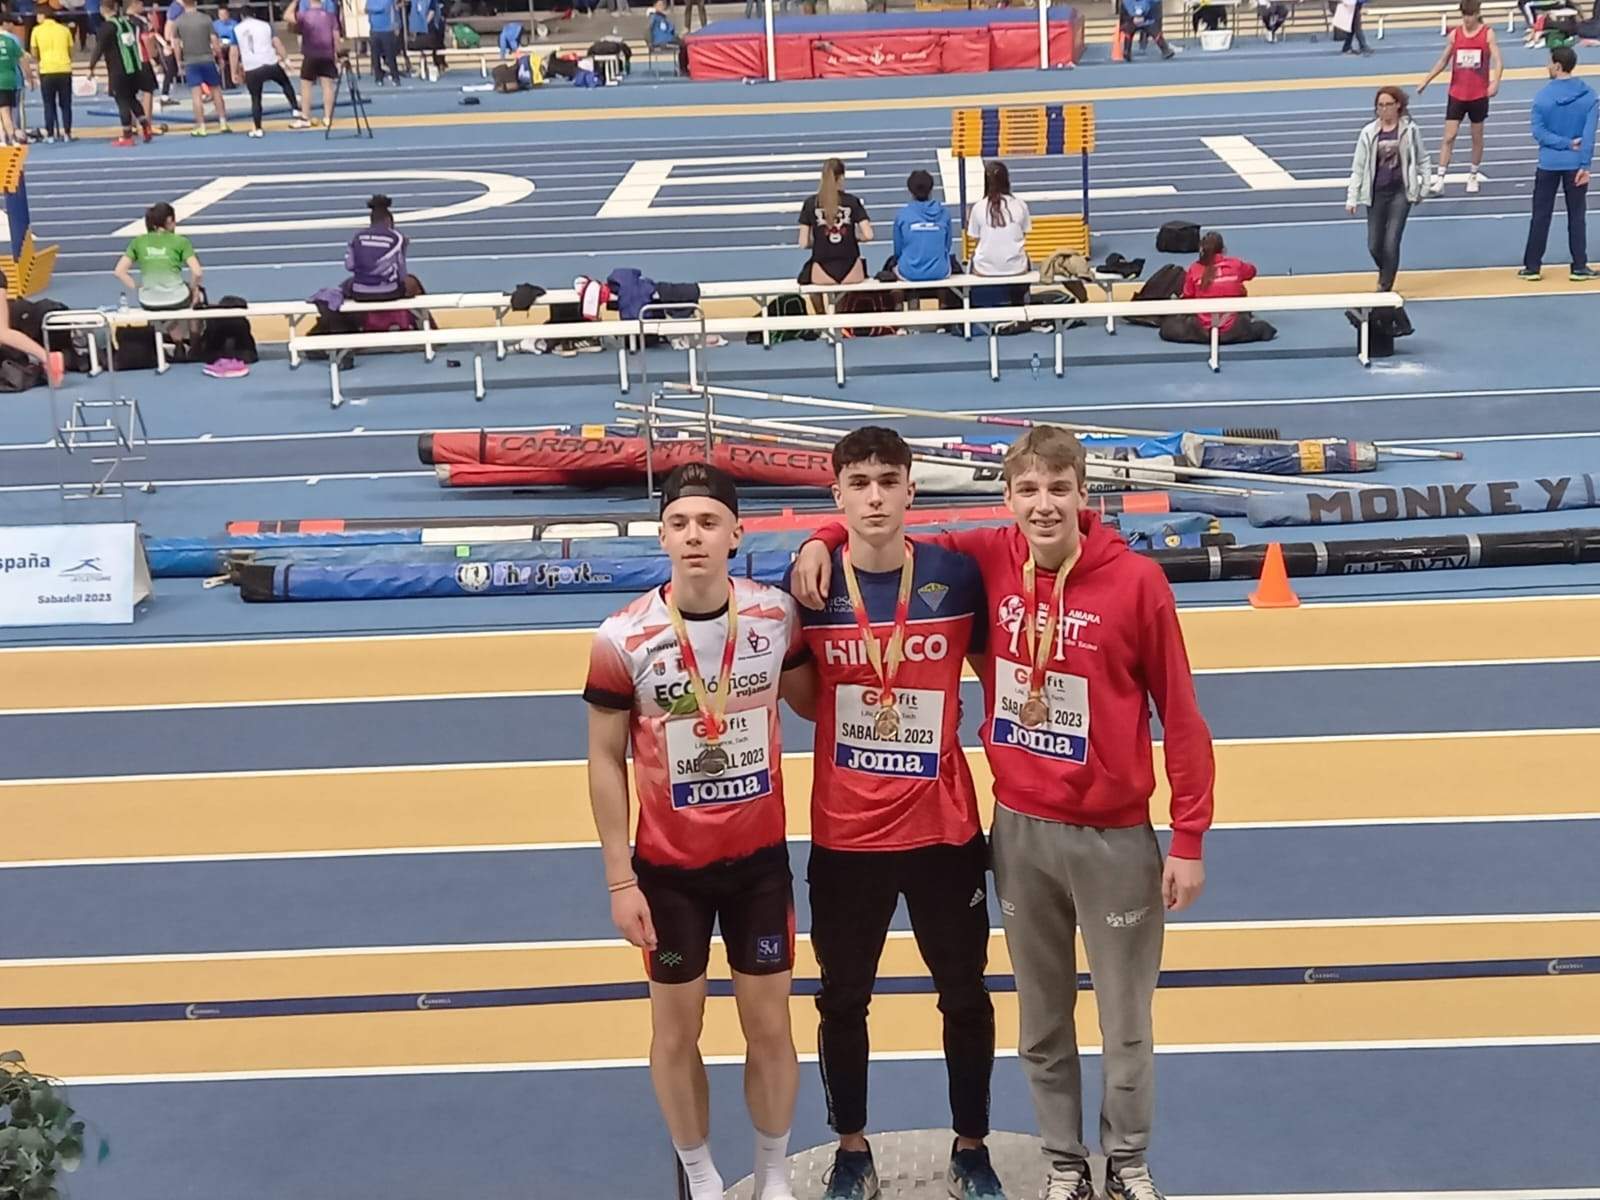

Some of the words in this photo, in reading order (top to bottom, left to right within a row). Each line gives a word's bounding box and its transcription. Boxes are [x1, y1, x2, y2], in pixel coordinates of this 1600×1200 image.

[500, 435, 624, 455] CARBON
[729, 446, 832, 471] PACER
[1306, 477, 1572, 523] MONKEY
[37, 593, 82, 604] Sabadell
[84, 592, 112, 603] 2023
[1054, 709, 1083, 728] 2023
[904, 728, 934, 745] 2023
[740, 747, 765, 767] 2023
